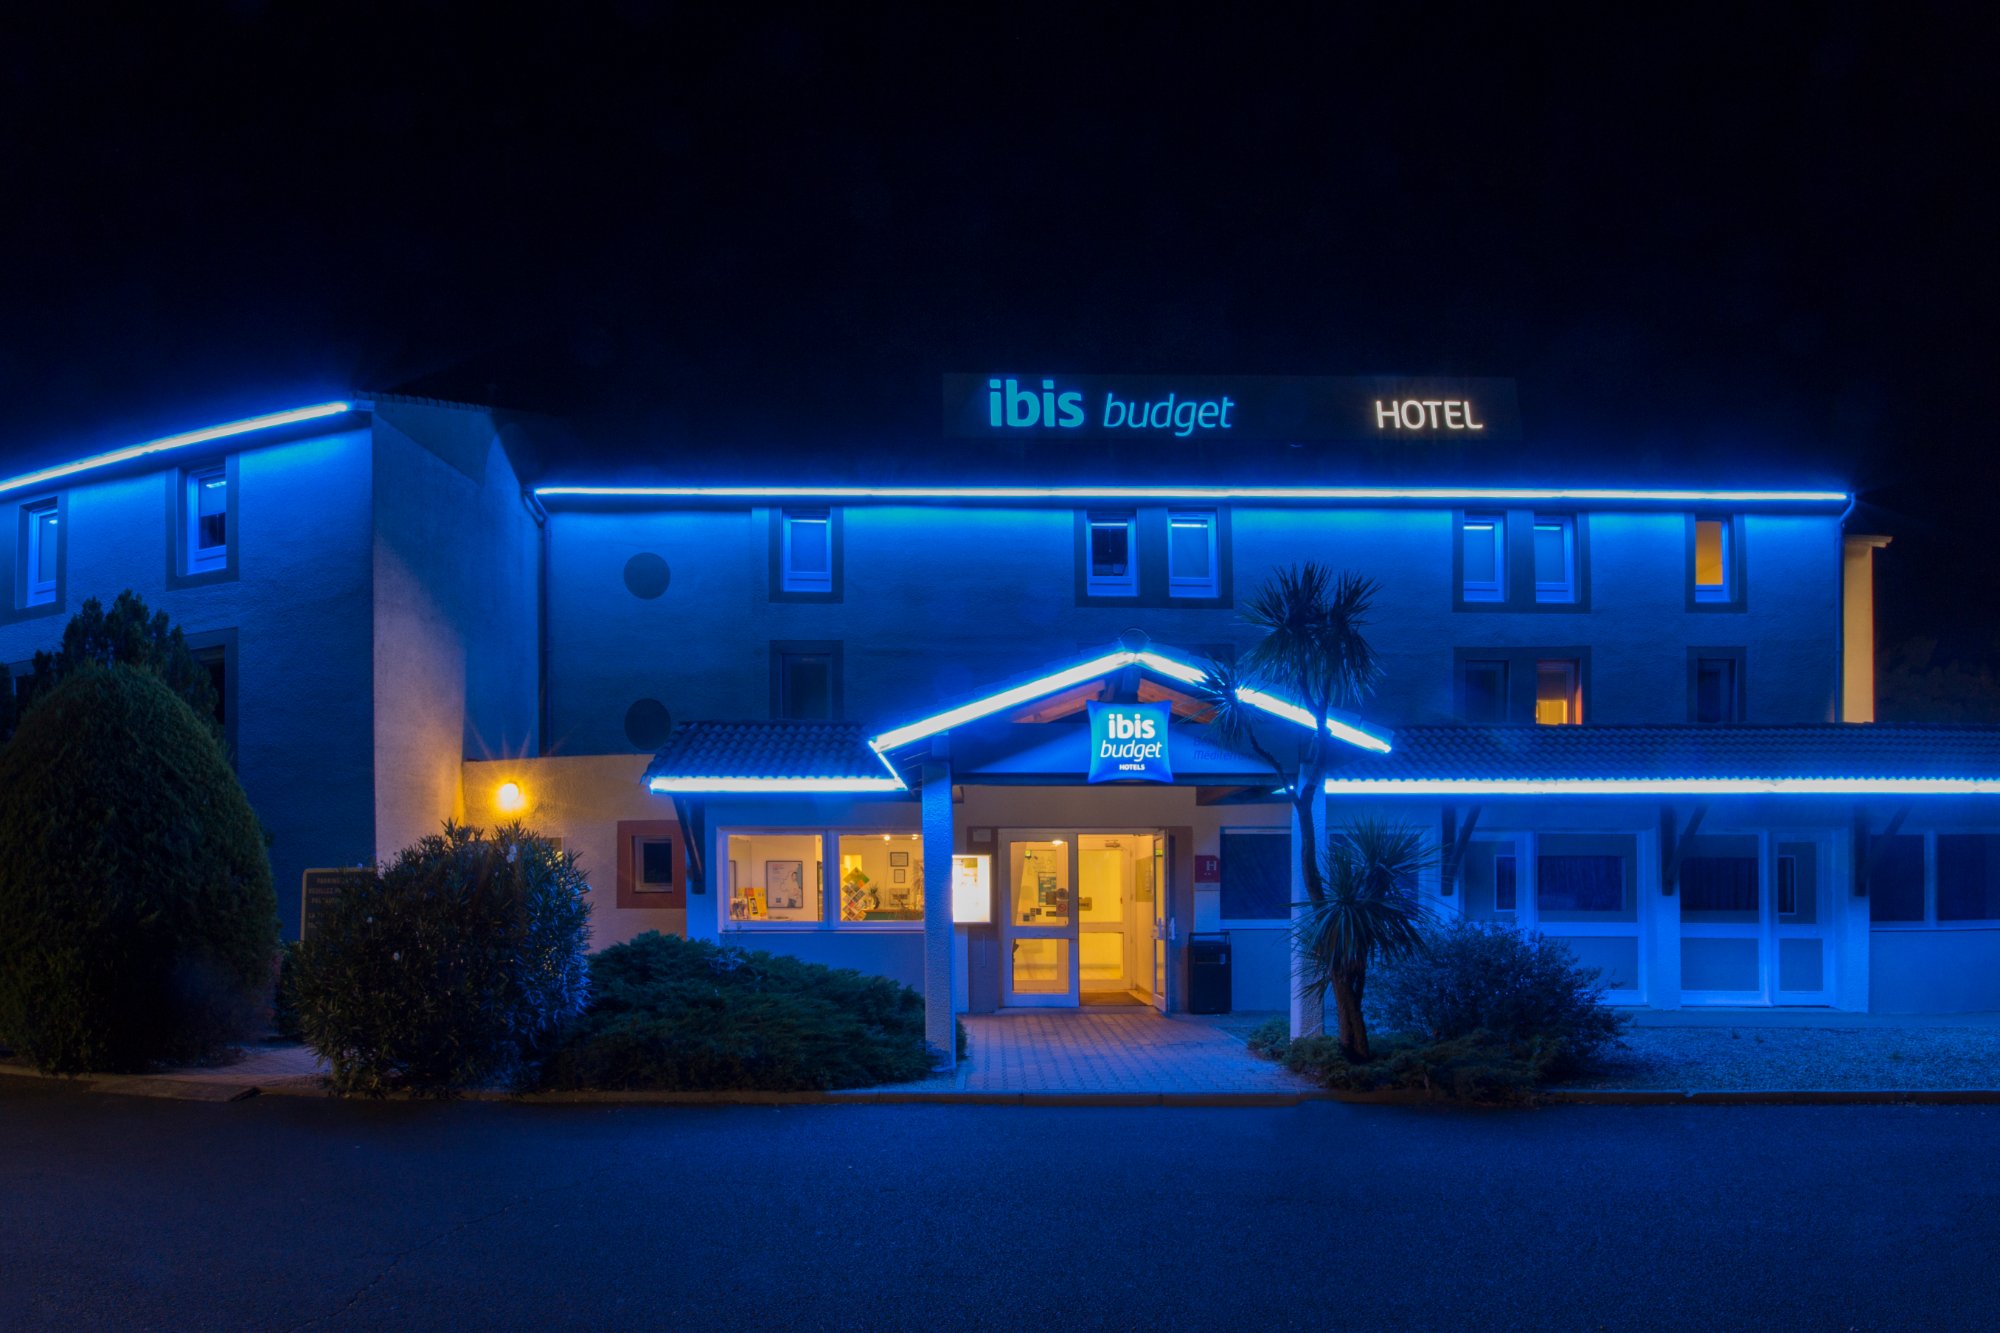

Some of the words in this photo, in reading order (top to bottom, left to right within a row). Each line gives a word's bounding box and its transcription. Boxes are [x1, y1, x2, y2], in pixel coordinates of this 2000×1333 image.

[989, 378, 1085, 428] ibis
[1103, 392, 1236, 437] budget
[1374, 398, 1485, 431] HOTEL
[1108, 713, 1156, 739] ibis
[1100, 739, 1163, 763] budget
[1118, 763, 1146, 771] HOTELS
[1206, 860, 1217, 871] H
